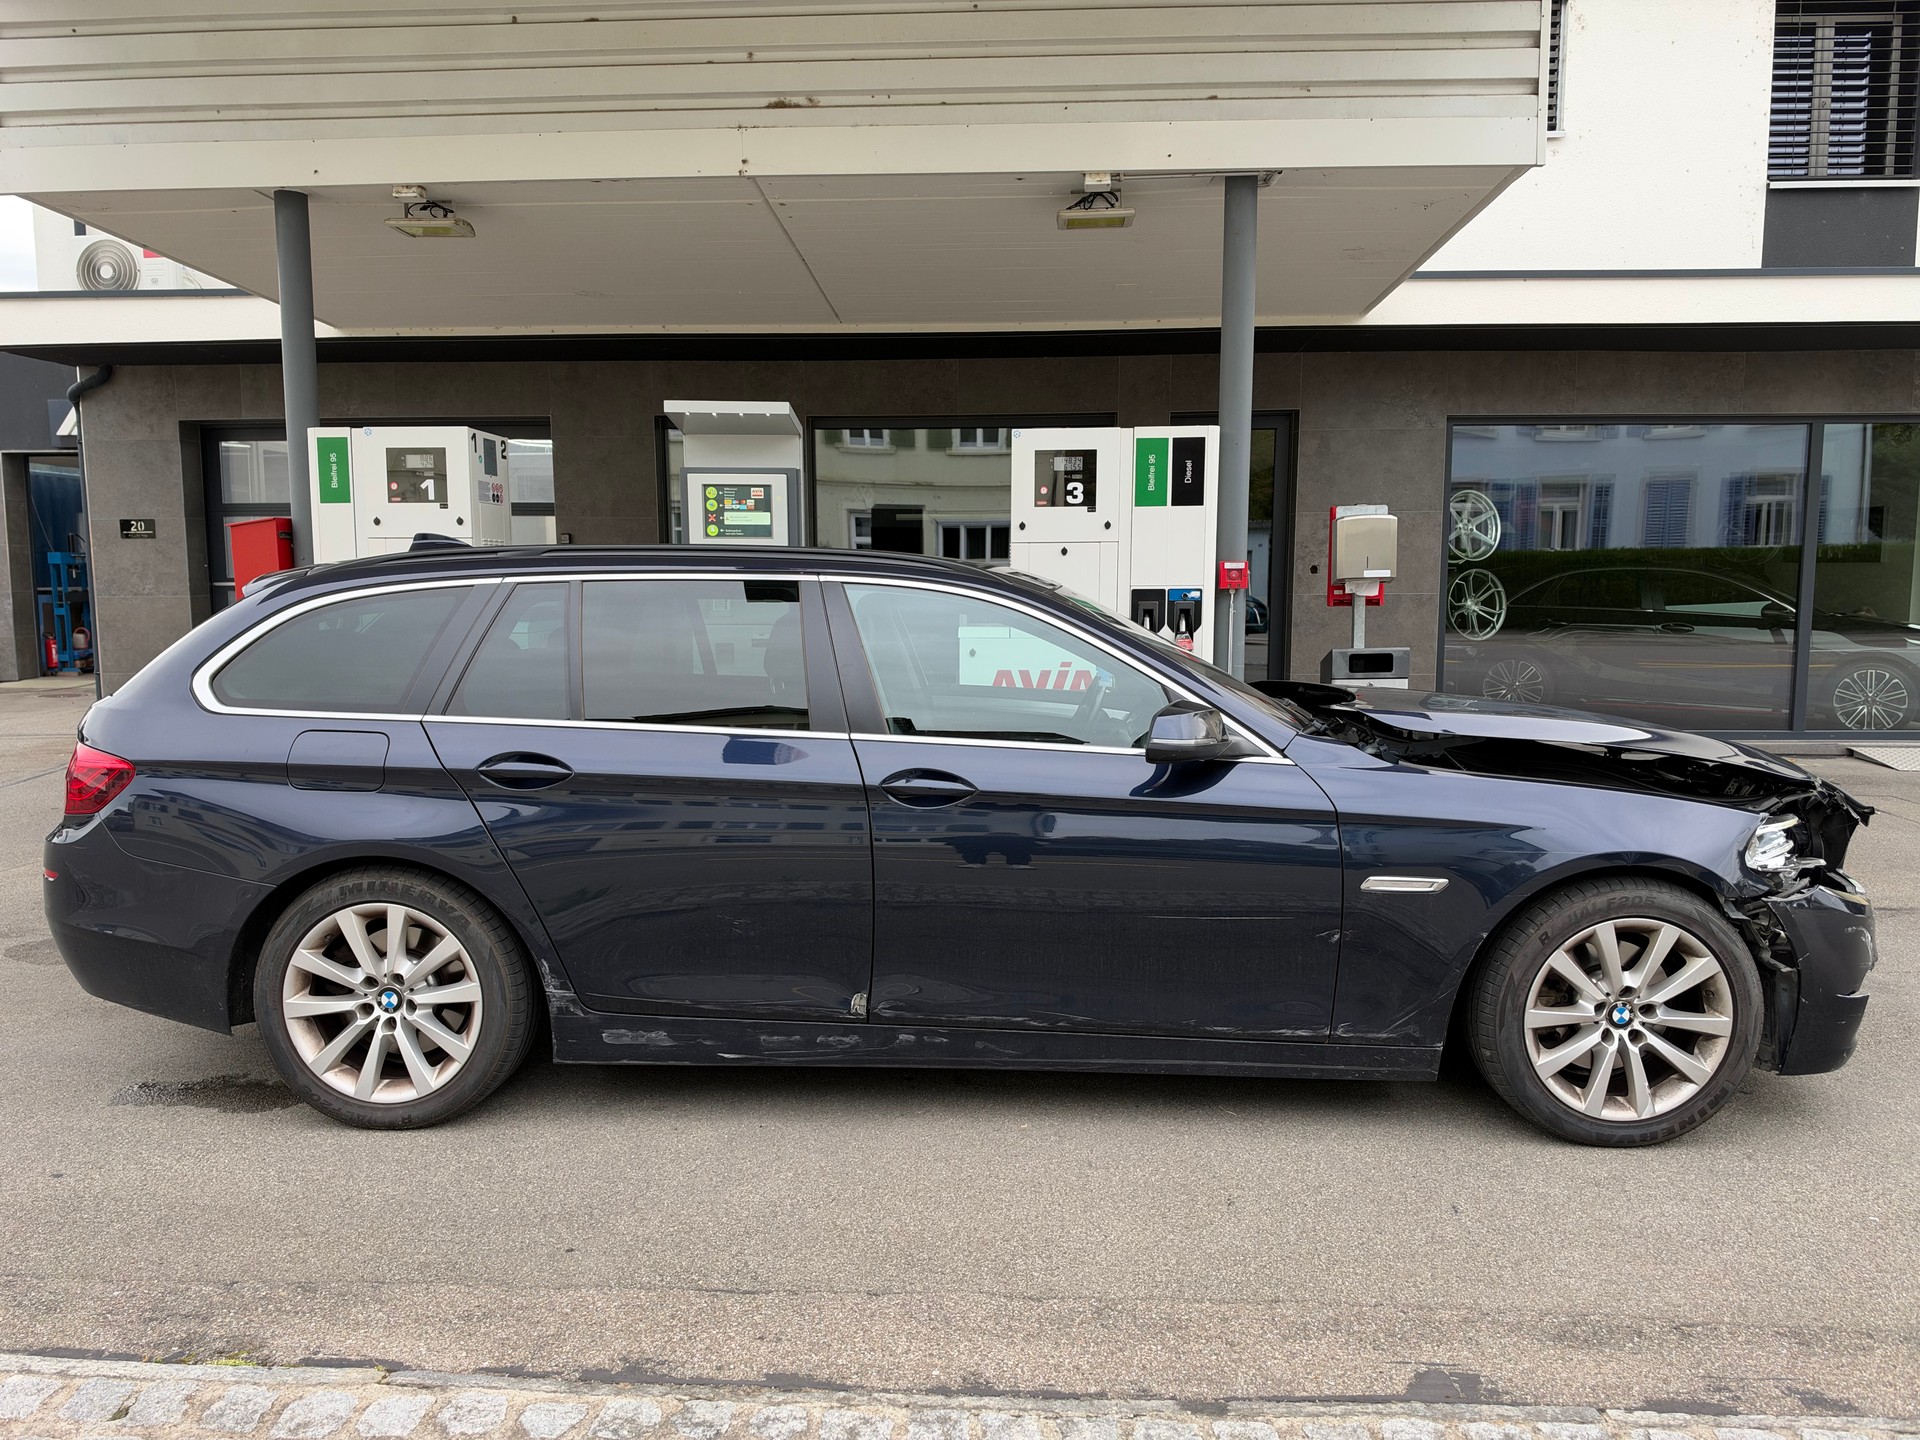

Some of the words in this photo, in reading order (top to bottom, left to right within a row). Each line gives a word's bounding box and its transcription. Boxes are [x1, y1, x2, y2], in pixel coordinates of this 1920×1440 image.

[470, 432, 478, 454] 1
[500, 439, 508, 460] 2
[329, 452, 337, 463] 95
[1148, 454, 1156, 464] 95
[330, 464, 339, 489] Bleifrei
[1147, 466, 1156, 491] Bleifrei
[1184, 460, 1193, 484] Diesel
[420, 478, 435, 501] 1
[1066, 481, 1084, 505] 3
[130, 521, 145, 531] 20
